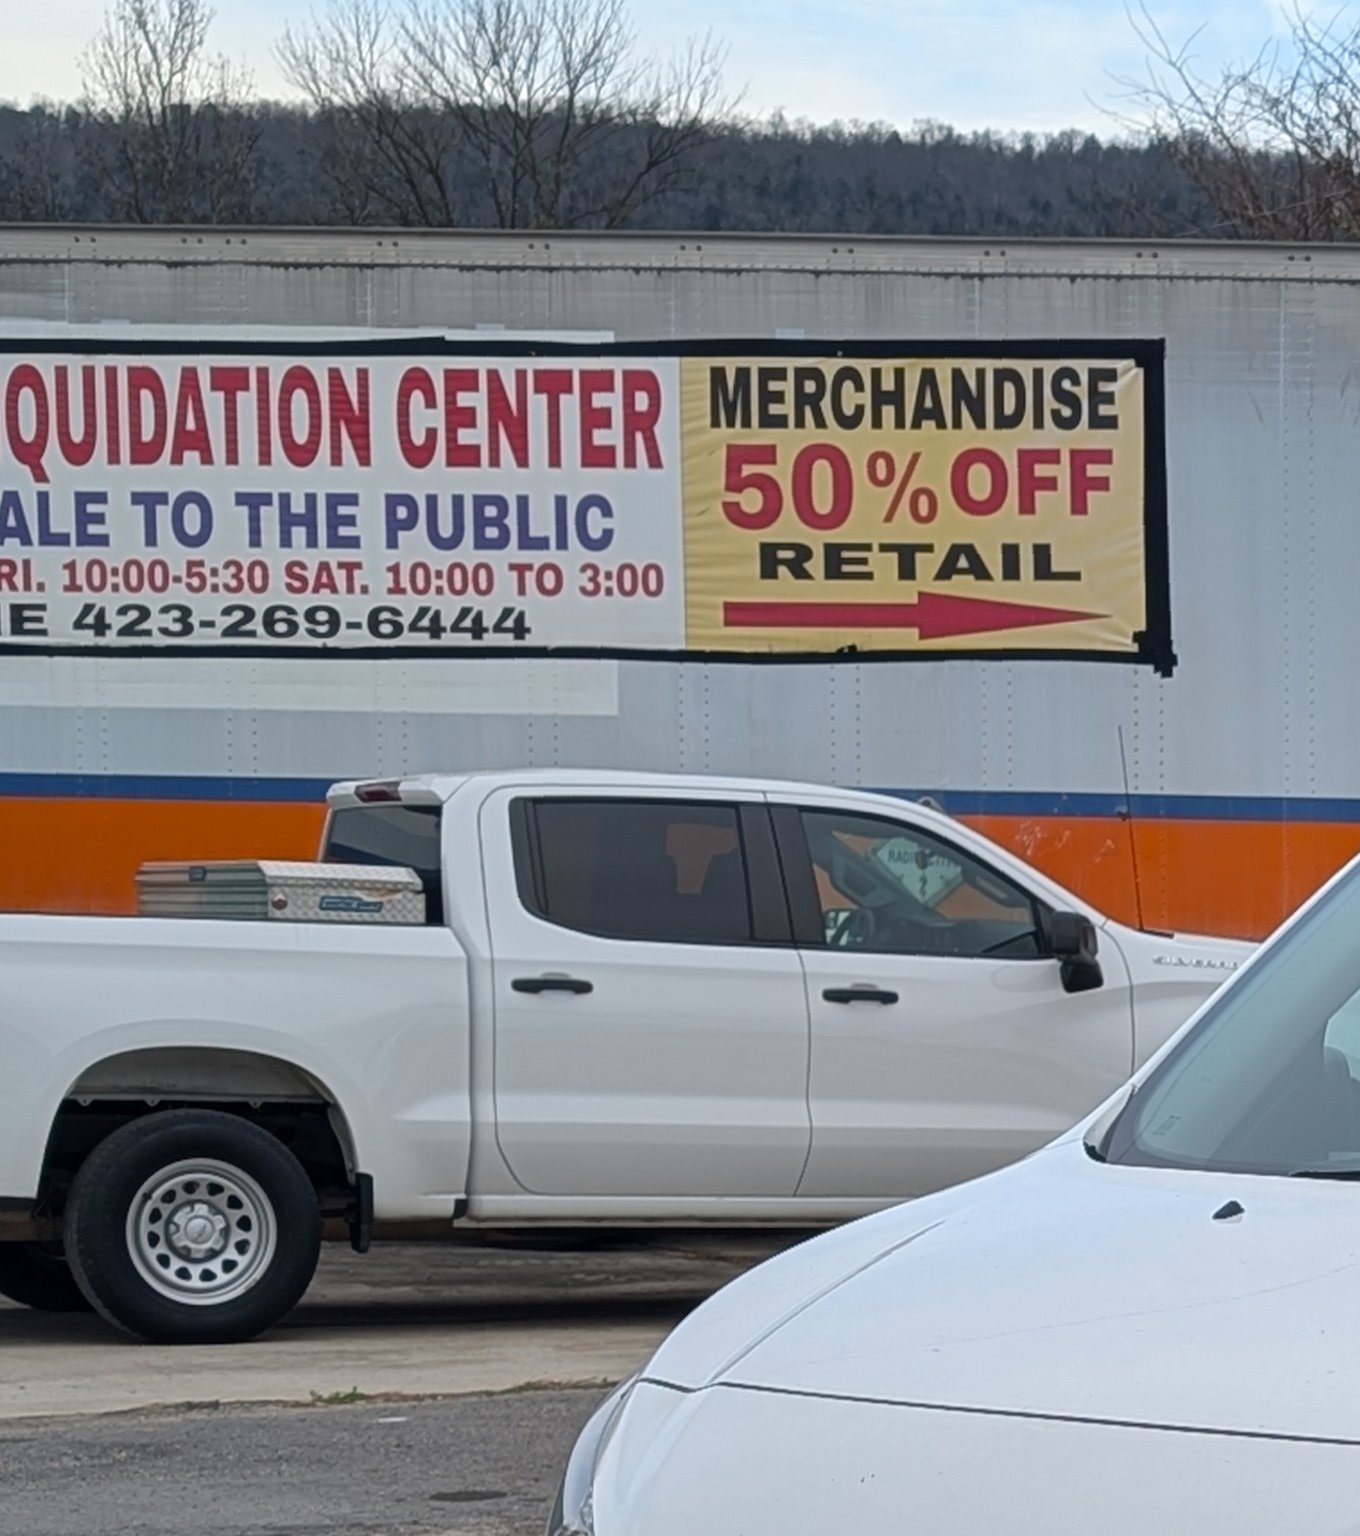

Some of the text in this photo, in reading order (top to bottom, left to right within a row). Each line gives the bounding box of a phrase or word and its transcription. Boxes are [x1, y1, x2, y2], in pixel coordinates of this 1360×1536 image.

[5, 364, 664, 483] QUIDATION CENTER
[709, 366, 1119, 431] MERCHANDISE
[721, 443, 1113, 530] 50% OFF
[0, 491, 615, 552] ALE TO THE PUBLIC
[62, 558, 270, 594] 10:00-5:30
[284, 561, 370, 595] SAT.
[386, 562, 494, 596] 10:00
[508, 563, 564, 597] TO
[578, 563, 664, 598] 3:00
[758, 542, 1082, 581] RETAIL
[0, 603, 532, 640] E 423-269-6444
